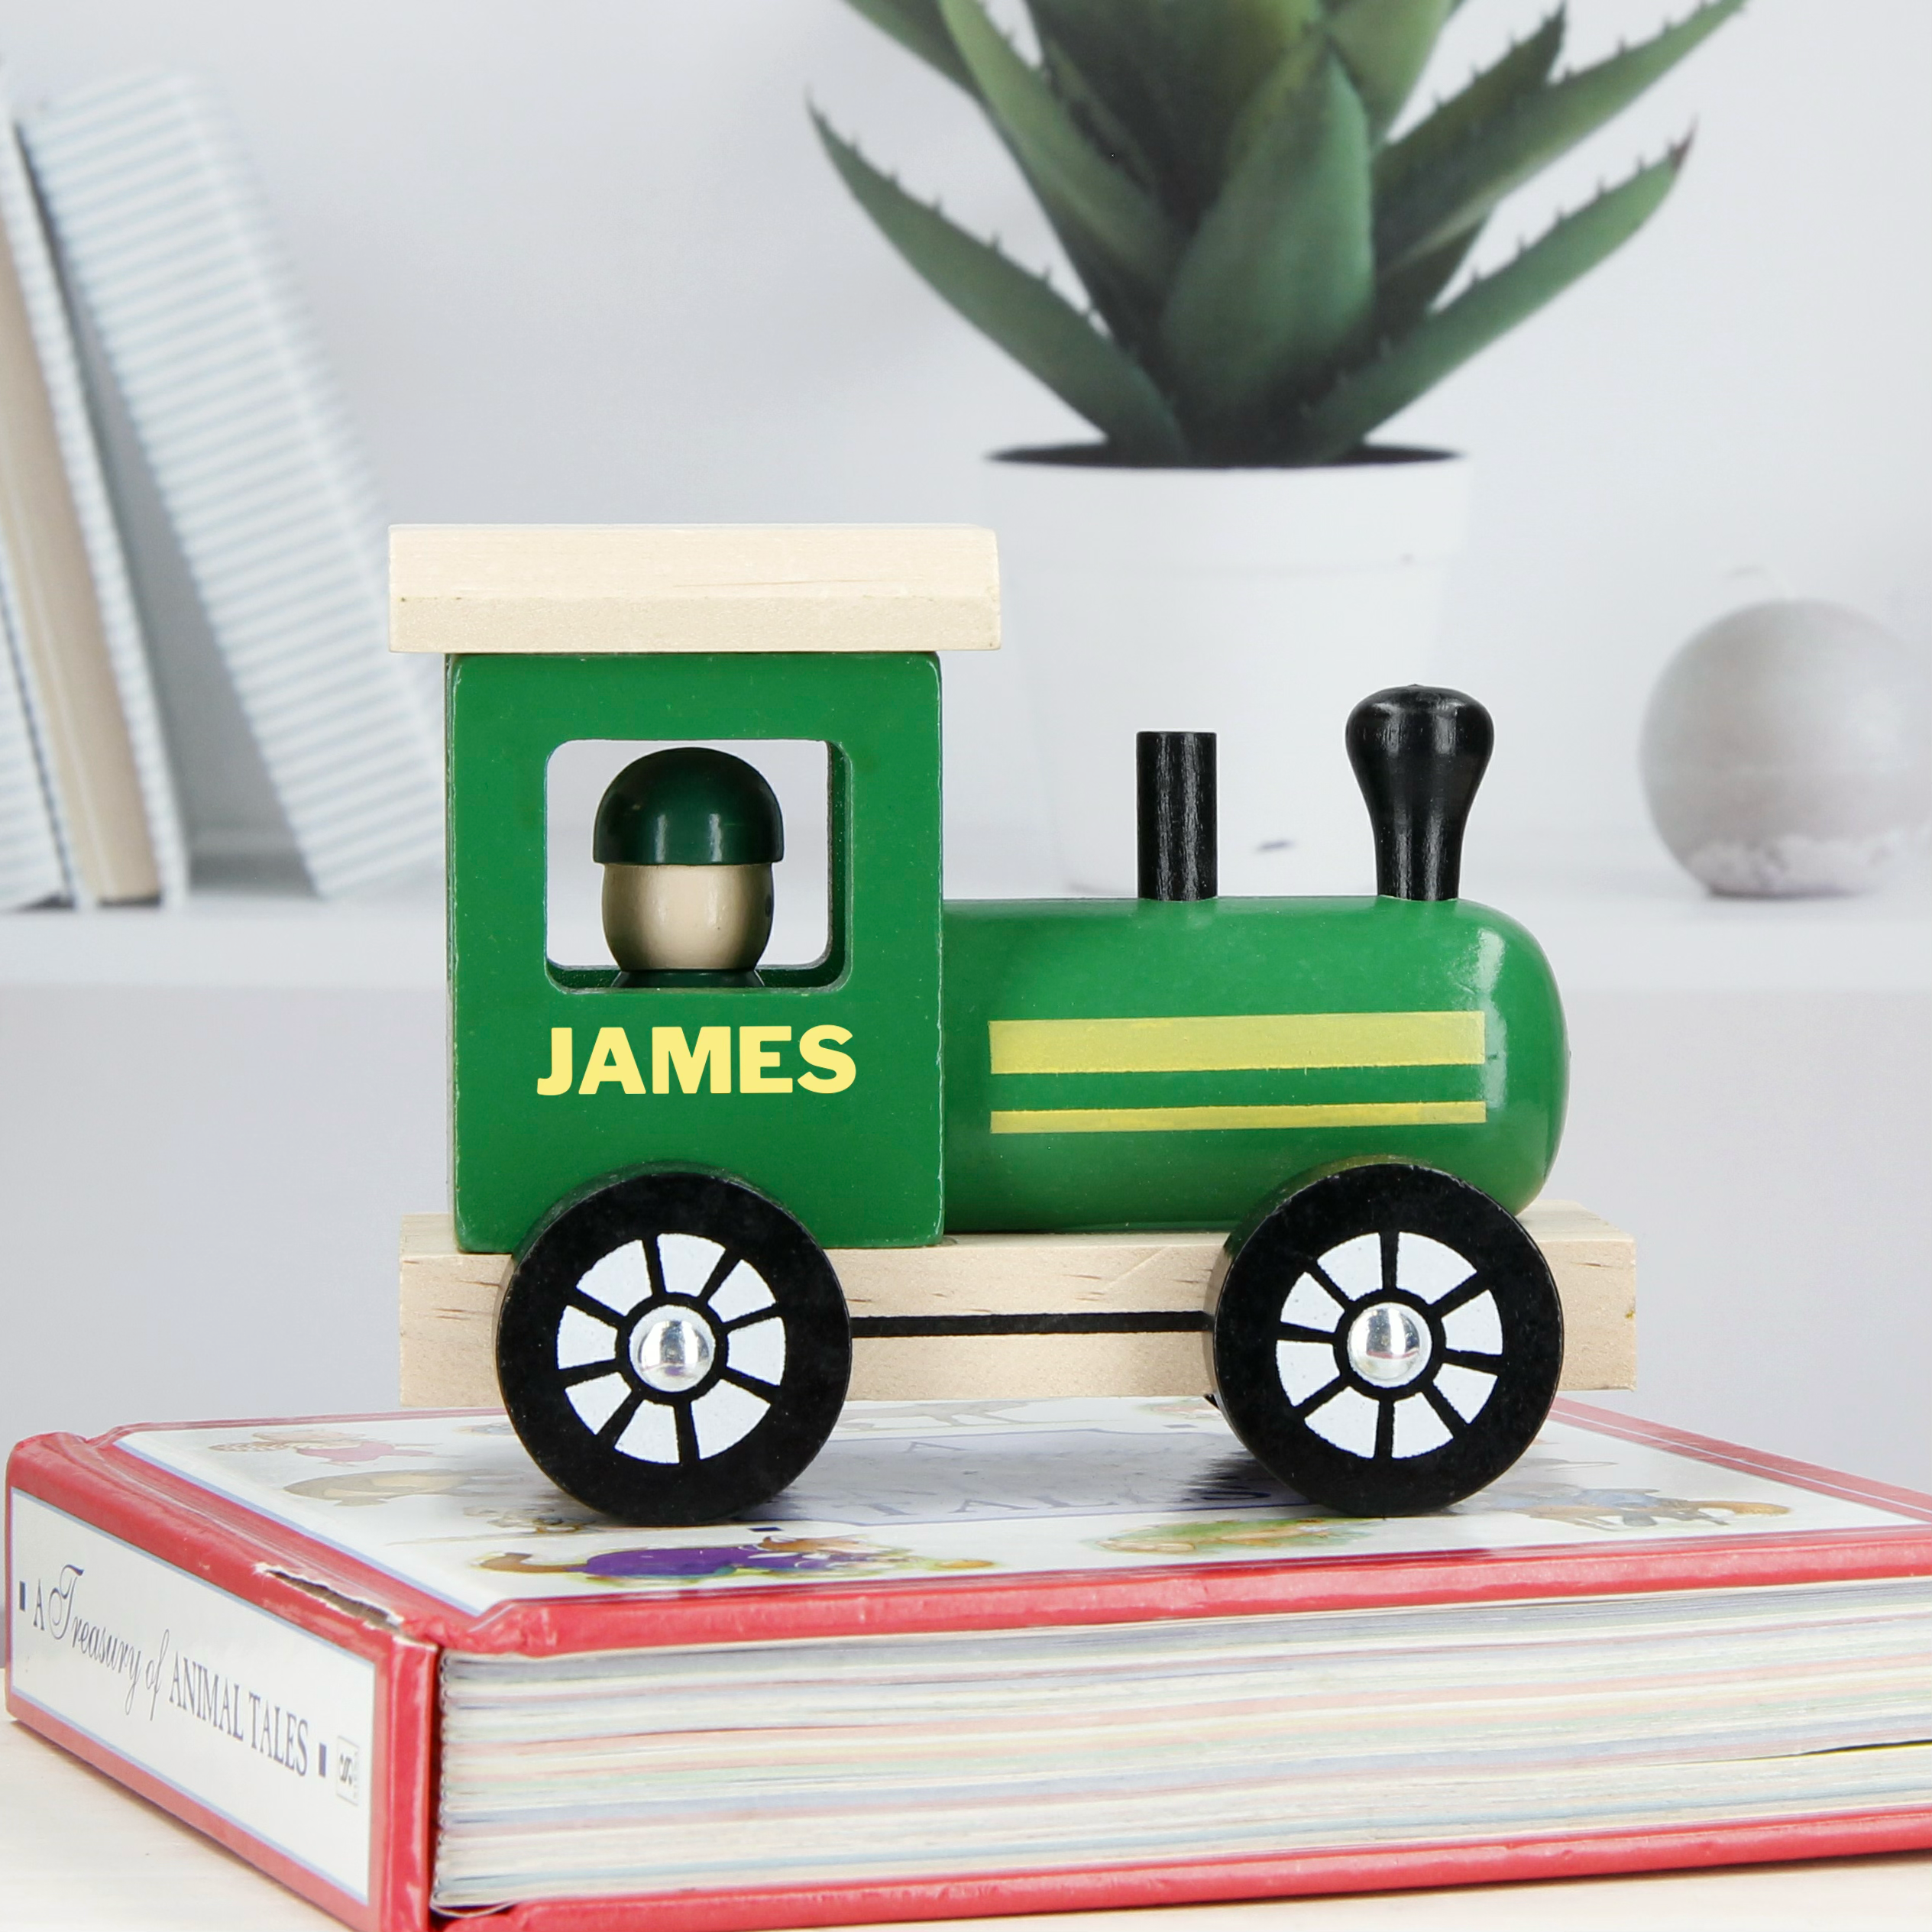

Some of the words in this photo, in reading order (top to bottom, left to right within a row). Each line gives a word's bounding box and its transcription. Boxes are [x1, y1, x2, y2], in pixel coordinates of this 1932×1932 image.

[536, 1024, 856, 1096] JAMES
[34, 1579, 45, 1630] A
[49, 1565, 141, 1715] Treasury
[145, 1629, 170, 1721] of
[169, 1652, 244, 1742] ANIMAL
[248, 1691, 308, 1777] TALES
